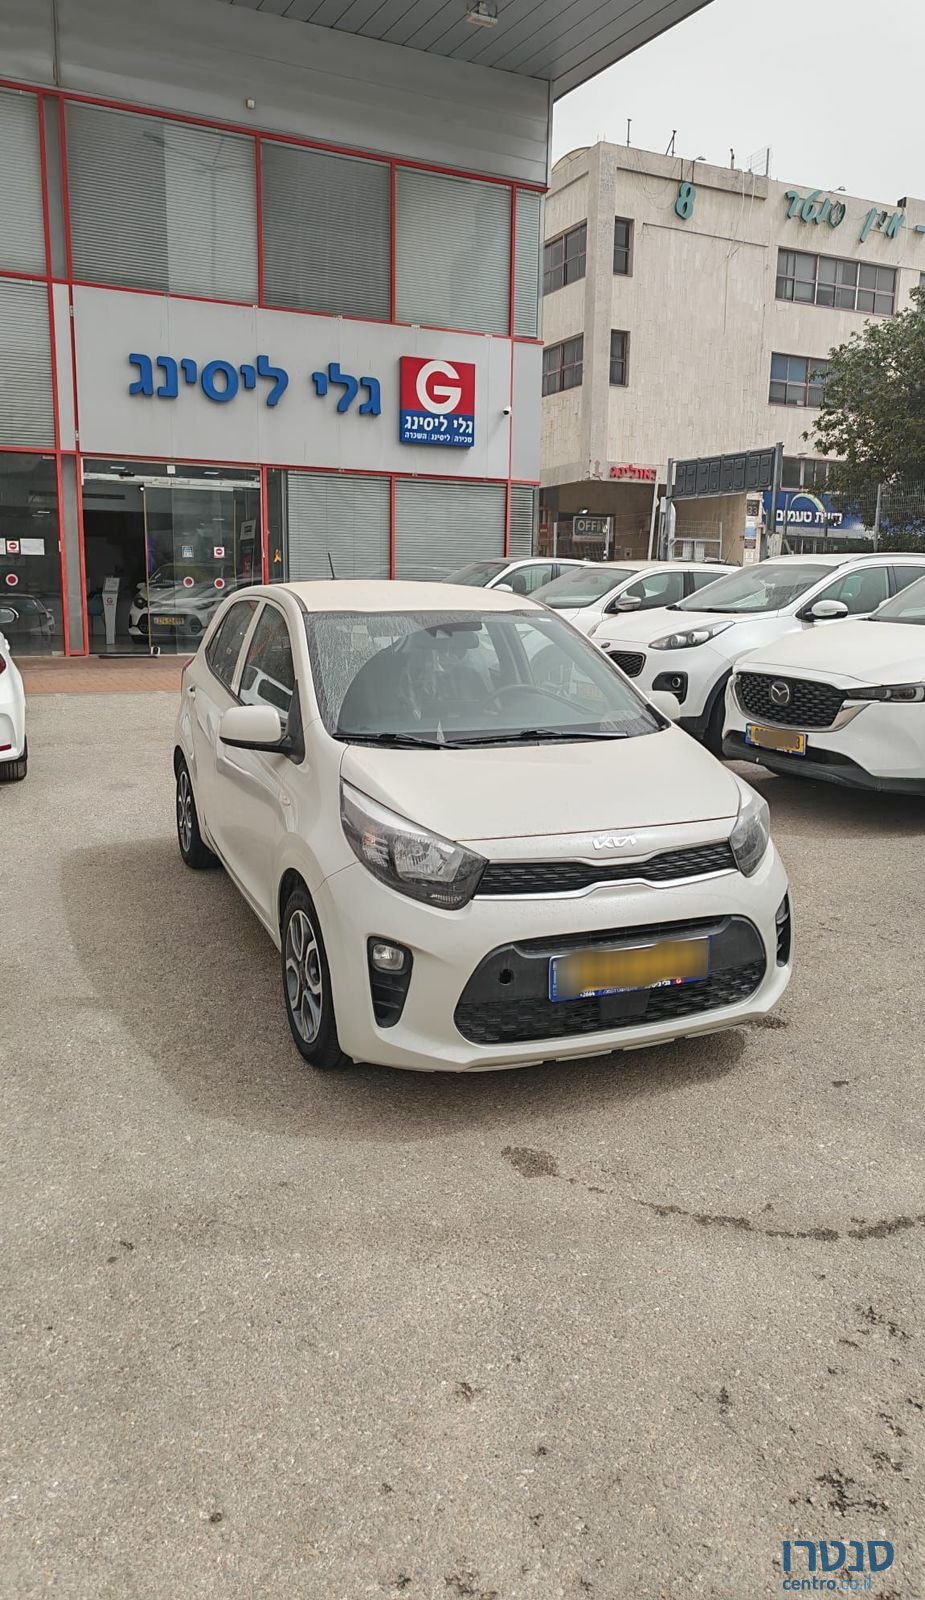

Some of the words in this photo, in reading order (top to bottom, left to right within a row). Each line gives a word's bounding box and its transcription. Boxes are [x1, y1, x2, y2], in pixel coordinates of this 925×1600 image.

[674, 181, 696, 221] 8
[128, 353, 289, 407] ליסינג
[415, 360, 462, 415] G
[312, 363, 381, 416] גלי
[404, 415, 448, 432] ליסינג
[453, 417, 473, 434] גלי
[404, 431, 427, 440] השכרה
[431, 433, 450, 442] ליסינג
[775, 509, 812, 523] טעמים
[592, 835, 638, 850] KIA
